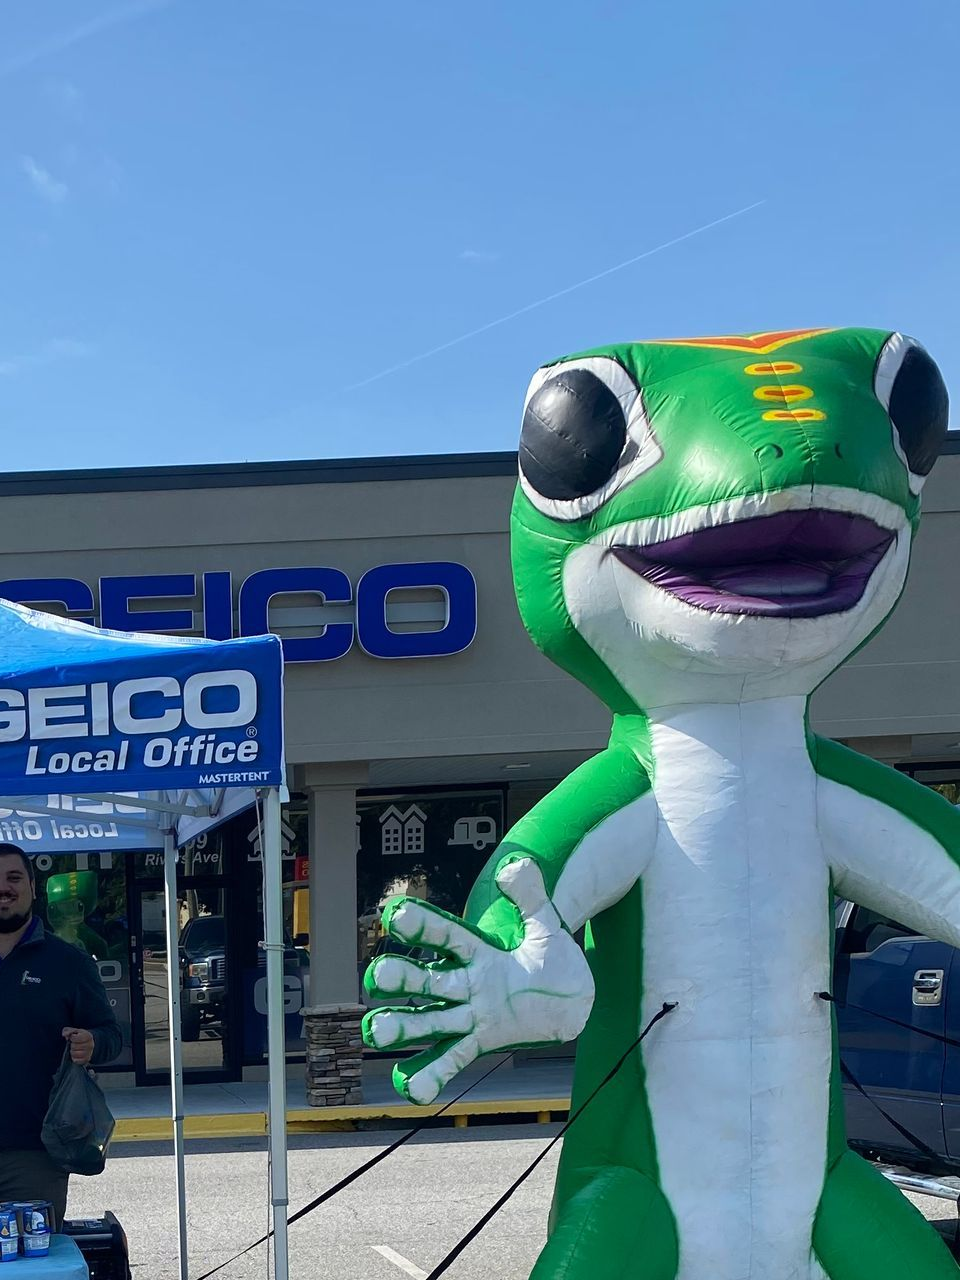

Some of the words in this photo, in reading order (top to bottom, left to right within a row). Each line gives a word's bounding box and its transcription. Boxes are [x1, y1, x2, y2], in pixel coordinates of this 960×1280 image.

[25, 740, 128, 775] Local
[143, 734, 258, 768] Office
[198, 771, 270, 784] MASTERTENT
[145, 853, 187, 866] Rivs
[192, 852, 219, 863] Ave
